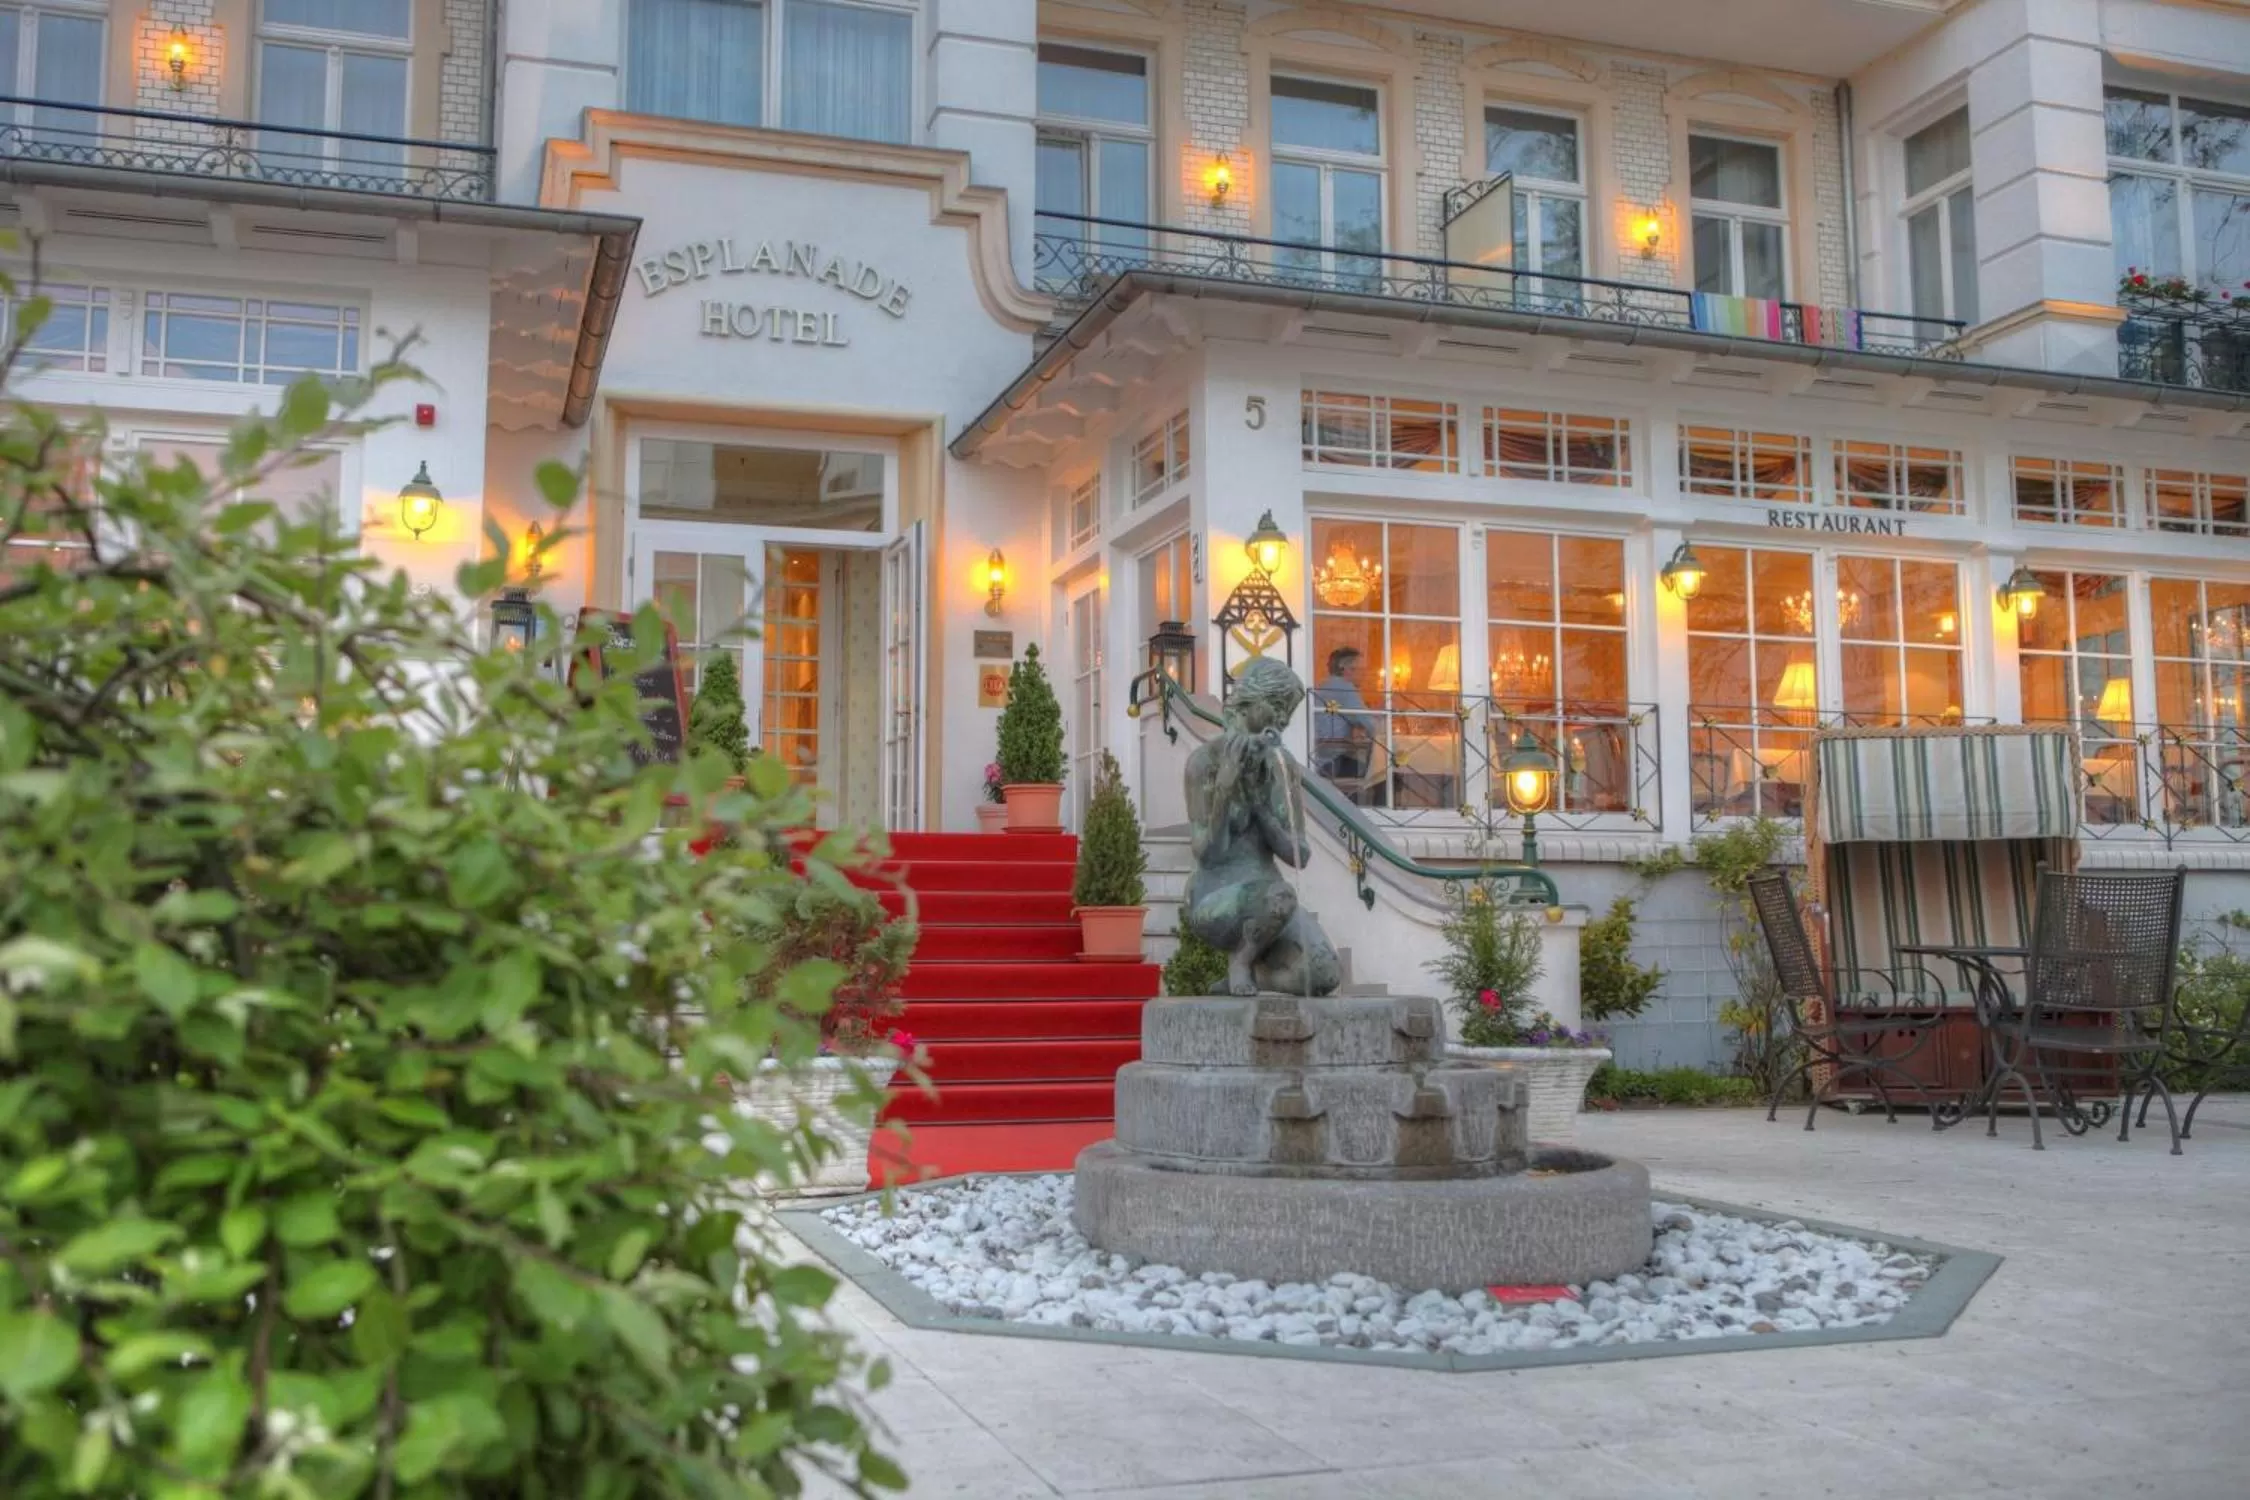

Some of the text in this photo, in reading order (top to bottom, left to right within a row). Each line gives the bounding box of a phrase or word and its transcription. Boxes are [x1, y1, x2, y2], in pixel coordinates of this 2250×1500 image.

[635, 238, 911, 318] ESPLANADE
[701, 300, 848, 346] HOTEL
[1245, 395, 1266, 431] 5
[1768, 509, 1906, 536] RESTAURANT
